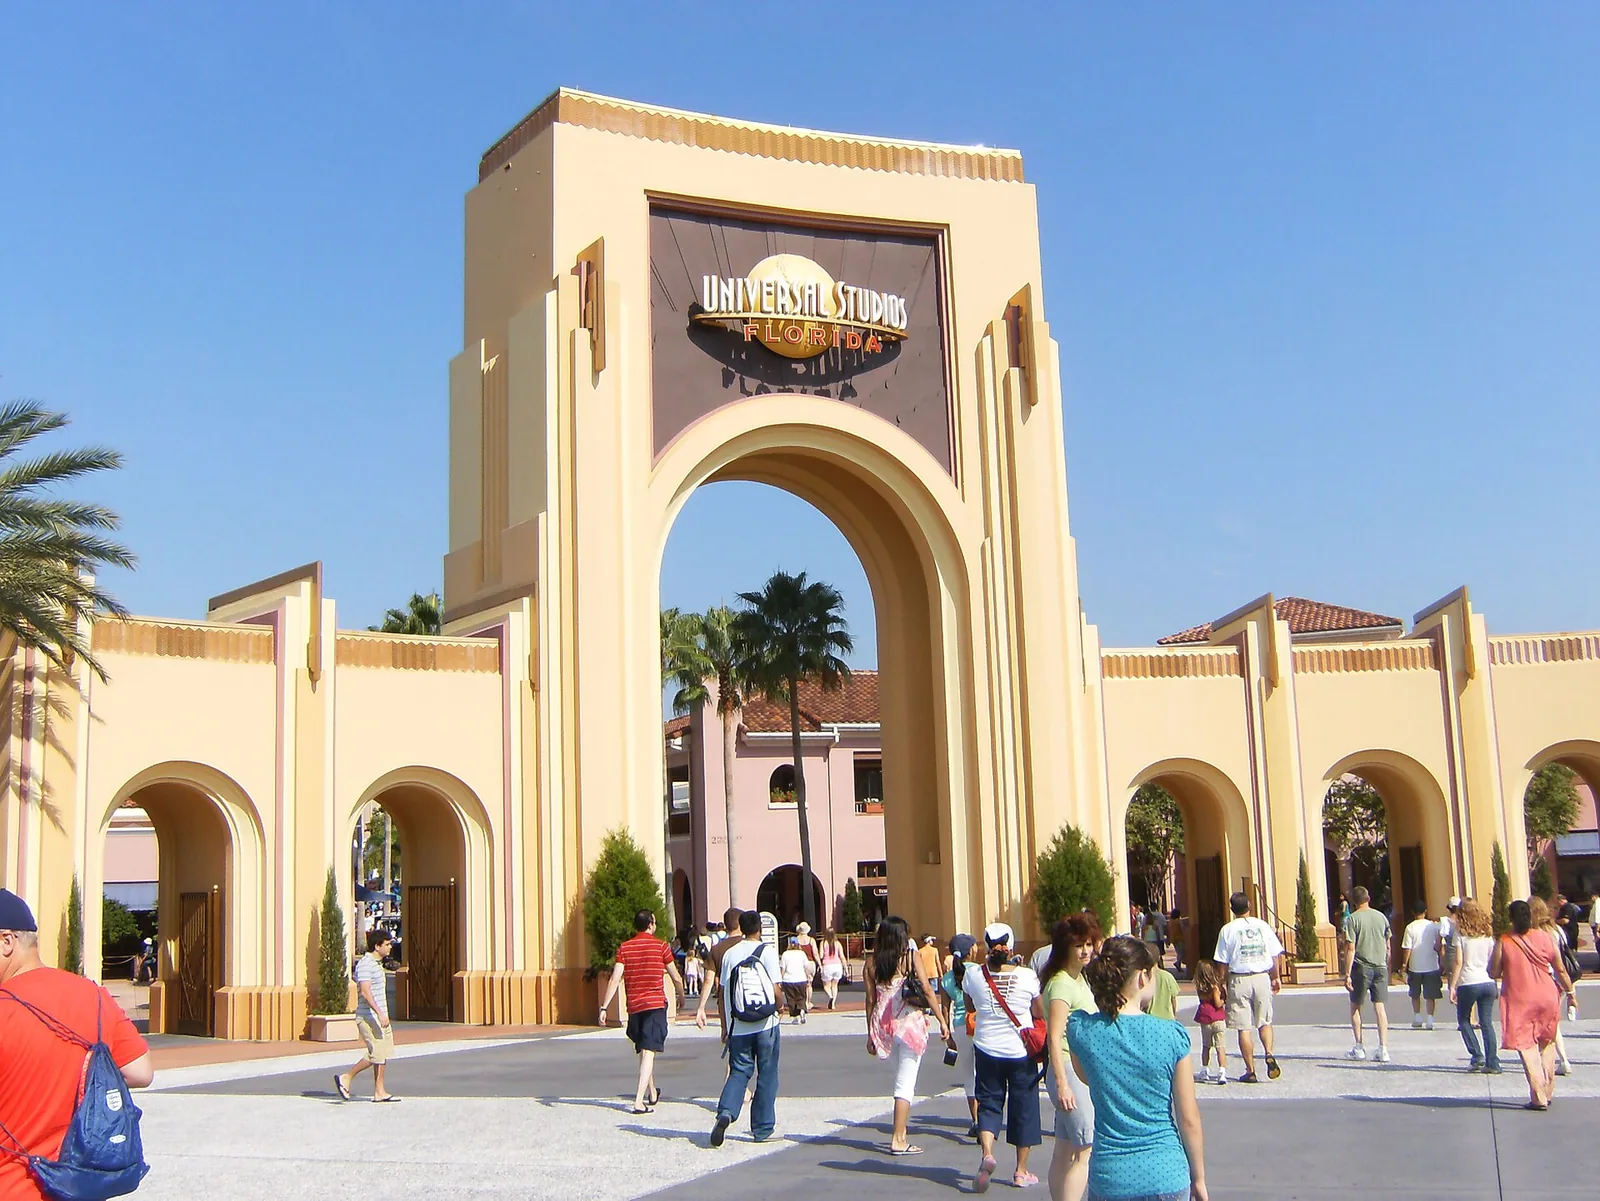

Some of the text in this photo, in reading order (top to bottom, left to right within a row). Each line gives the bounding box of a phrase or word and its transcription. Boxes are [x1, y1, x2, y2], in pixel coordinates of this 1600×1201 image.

[702, 274, 908, 330] UNIVERSAL STUDIOS
[743, 324, 882, 353] FLORIDA
[741, 966, 767, 1005] NIKE
